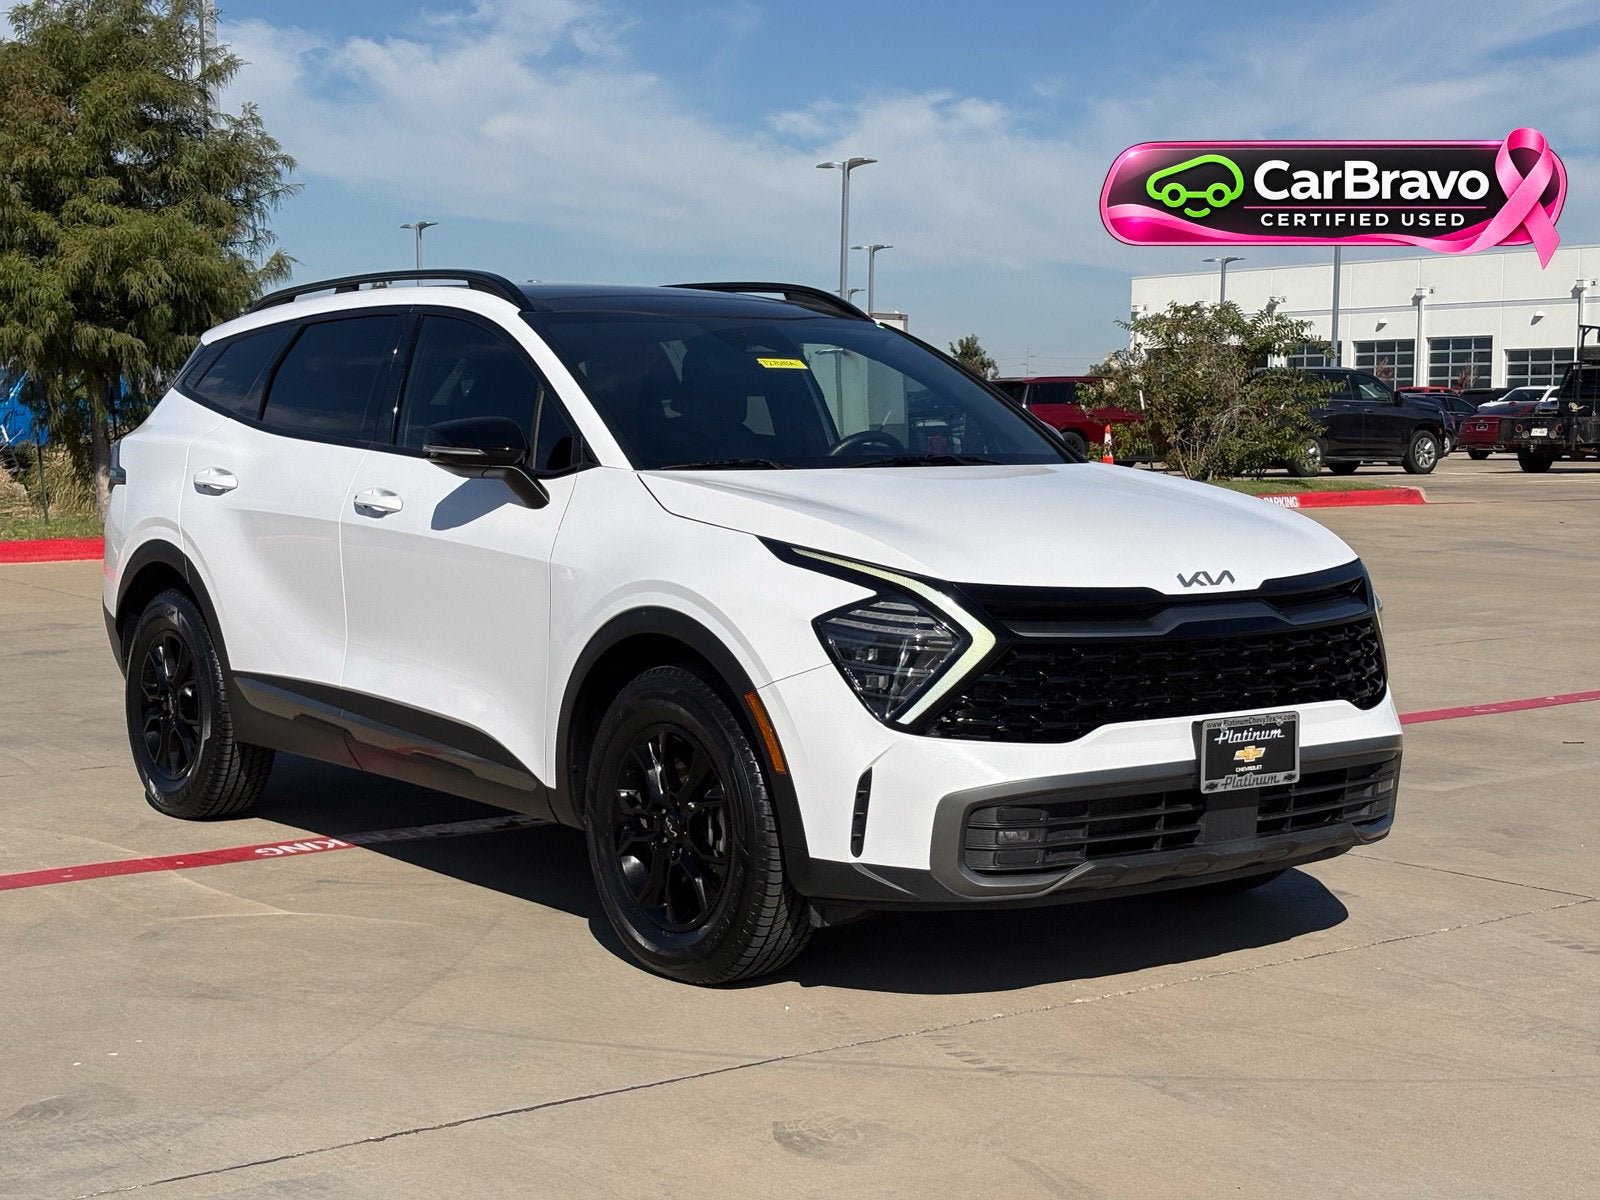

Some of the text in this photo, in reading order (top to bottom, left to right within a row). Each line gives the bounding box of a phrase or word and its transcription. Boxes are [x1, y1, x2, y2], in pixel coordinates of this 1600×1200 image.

[1176, 570, 1236, 587] KIA
[1206, 714, 1297, 728] wwwPlatinumChevyTexs.com
[1214, 727, 1286, 745] Platinum
[1235, 764, 1263, 773] CHEVROLET
[1221, 773, 1281, 790] Platinum
